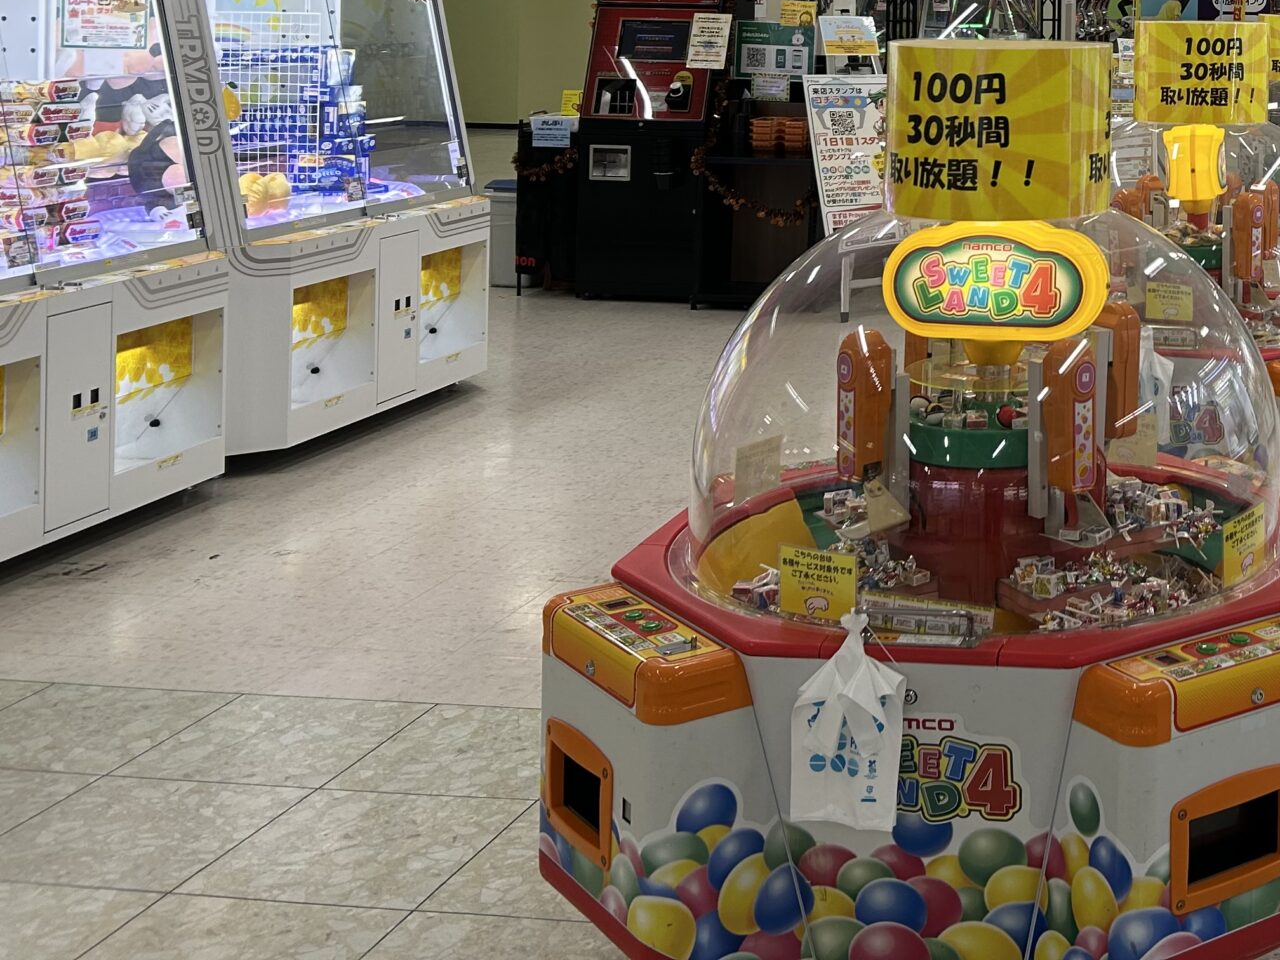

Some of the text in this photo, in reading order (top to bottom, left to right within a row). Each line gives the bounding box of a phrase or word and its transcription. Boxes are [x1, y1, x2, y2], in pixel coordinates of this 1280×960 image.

[1185, 37, 1243, 57] 100円
[175, 14, 224, 156] TRYPOD
[913, 71, 1007, 105] 100円
[1179, 62, 1245, 81] 30秒間
[812, 87, 863, 95] 来店スタンプは
[815, 96, 840, 104] コチラ
[1160, 86, 1255, 107] 取り放題!!
[906, 114, 1010, 149] 30秒間
[889, 152, 1036, 192] 取り放題!!
[962, 242, 1013, 252] namco
[919, 252, 1032, 289] SWEET
[913, 279, 1019, 320] LAND
[1020, 259, 1060, 318] 4
[903, 717, 956, 732] mco
[901, 735, 978, 783] EET
[962, 744, 1022, 821] 4
